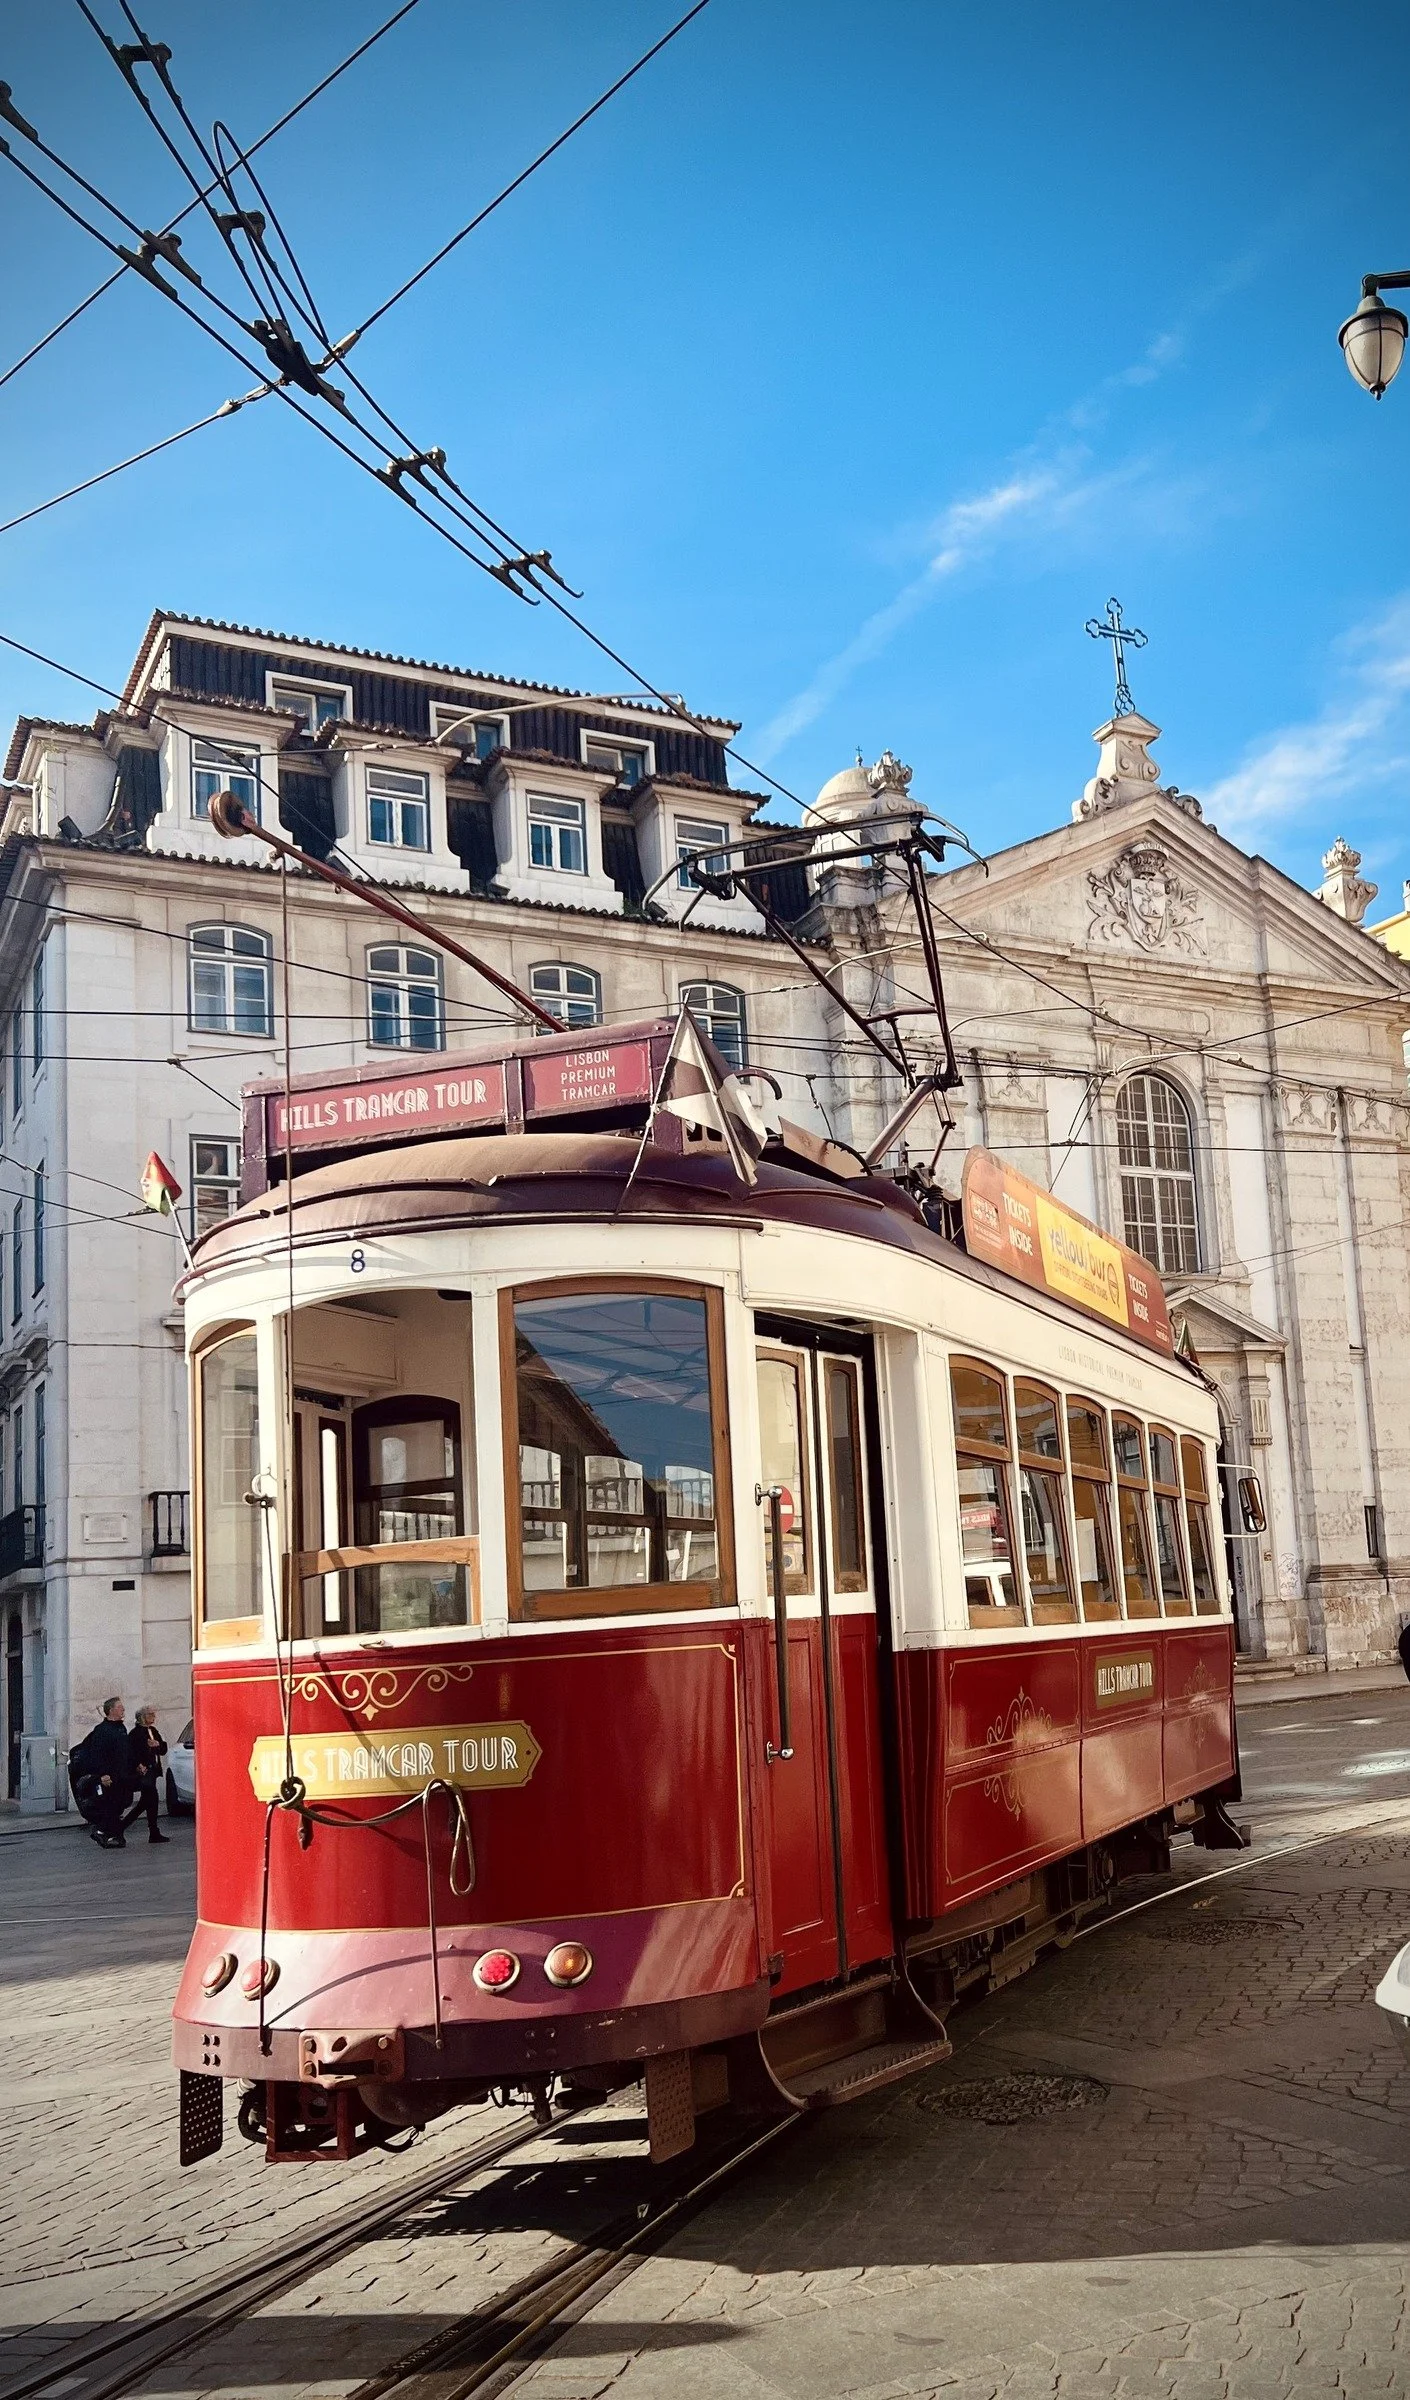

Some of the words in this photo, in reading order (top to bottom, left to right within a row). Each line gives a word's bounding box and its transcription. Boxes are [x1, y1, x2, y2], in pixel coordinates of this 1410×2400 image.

[565, 1049, 610, 1068] LISBON
[560, 1064, 616, 1085] PREMIUM
[280, 1100, 339, 1133] HILLS
[342, 1087, 430, 1124] TRAMCAR
[433, 1078, 488, 1106] TOUR
[561, 1082, 616, 1101] TRAMCAR
[1002, 1191, 1032, 1228] TICKETS
[1008, 1224, 1034, 1257] INSIDE
[350, 1248, 366, 1274] 8
[1127, 1273, 1149, 1299] TICKETS
[1097, 1666, 1116, 1696] HILLS
[323, 1741, 435, 1782] TRAMCAR
[442, 1736, 519, 1774] TOUR
